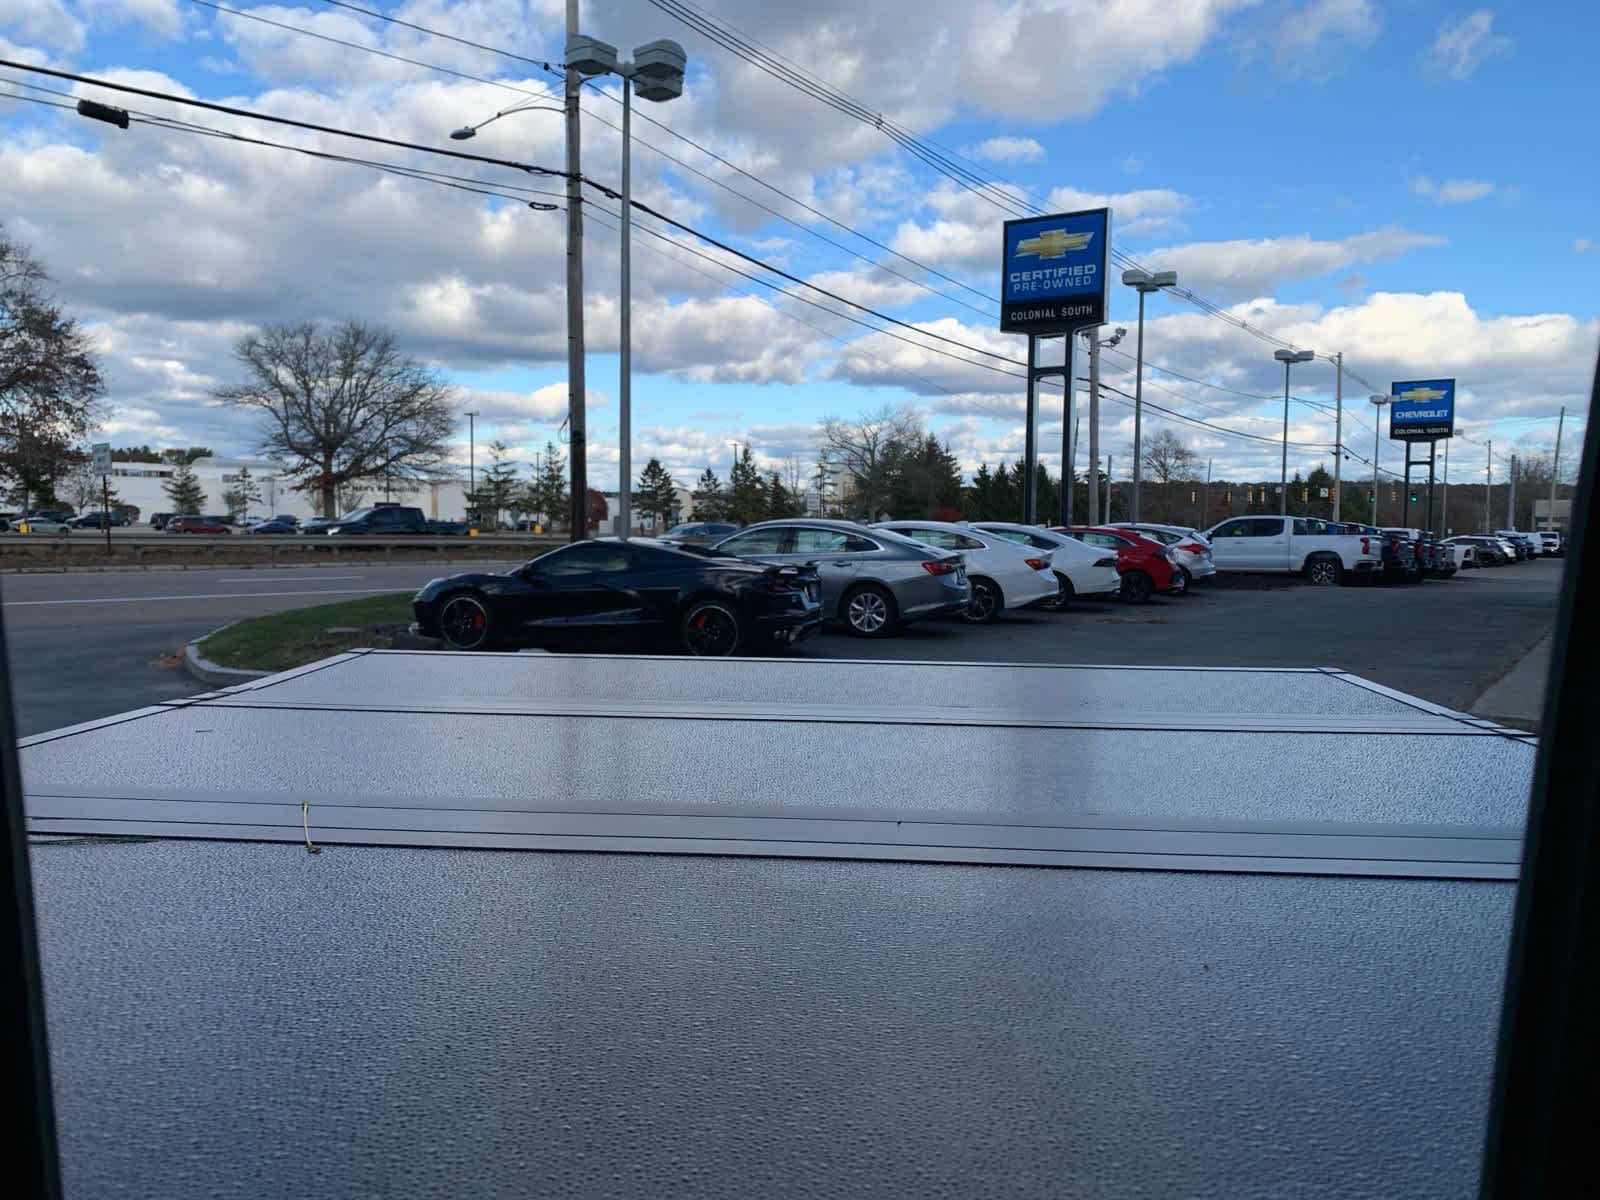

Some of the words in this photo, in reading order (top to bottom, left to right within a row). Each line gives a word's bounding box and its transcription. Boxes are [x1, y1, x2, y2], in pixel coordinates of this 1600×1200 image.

[1010, 264, 1097, 282] CERTIFIED
[1014, 276, 1091, 292] PRE-OWNED
[1011, 308, 1056, 320] COLONIAL
[1062, 305, 1092, 316] SOUTH
[1395, 409, 1448, 418] CHEVROLET
